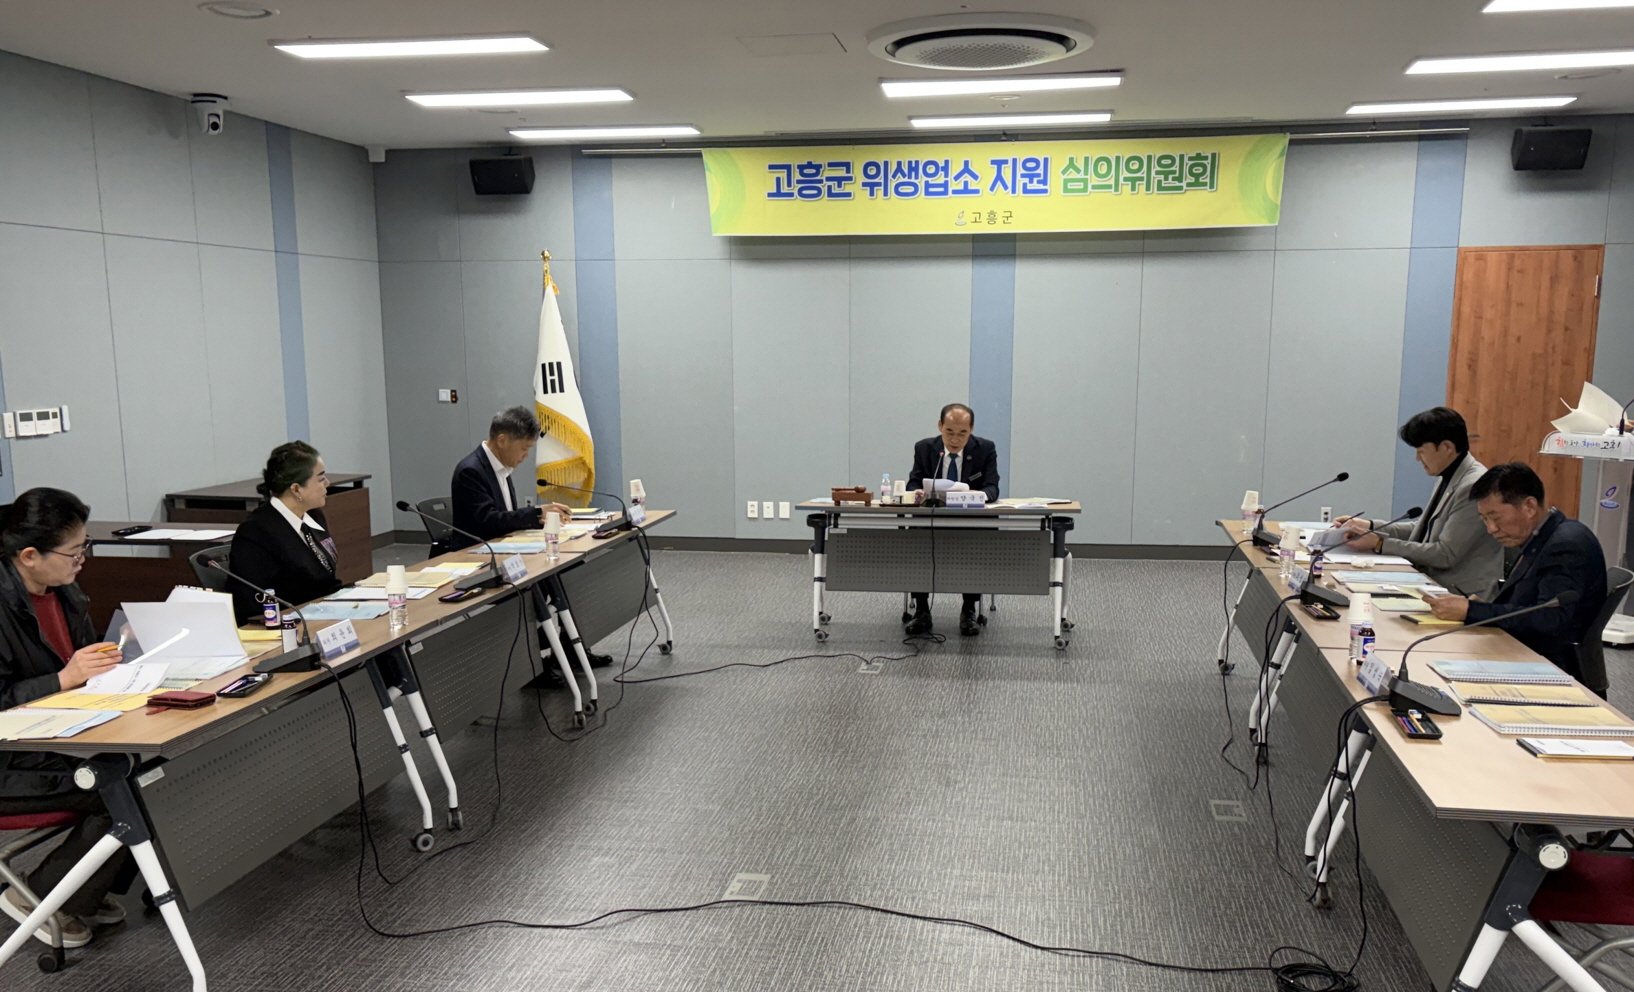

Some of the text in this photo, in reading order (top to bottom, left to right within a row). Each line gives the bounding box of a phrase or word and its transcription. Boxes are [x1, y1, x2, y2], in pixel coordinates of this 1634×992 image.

[766, 152, 1218, 199] 고흥군 위생업소 지원 심의위원회
[970, 210, 1014, 225] 고흥군
